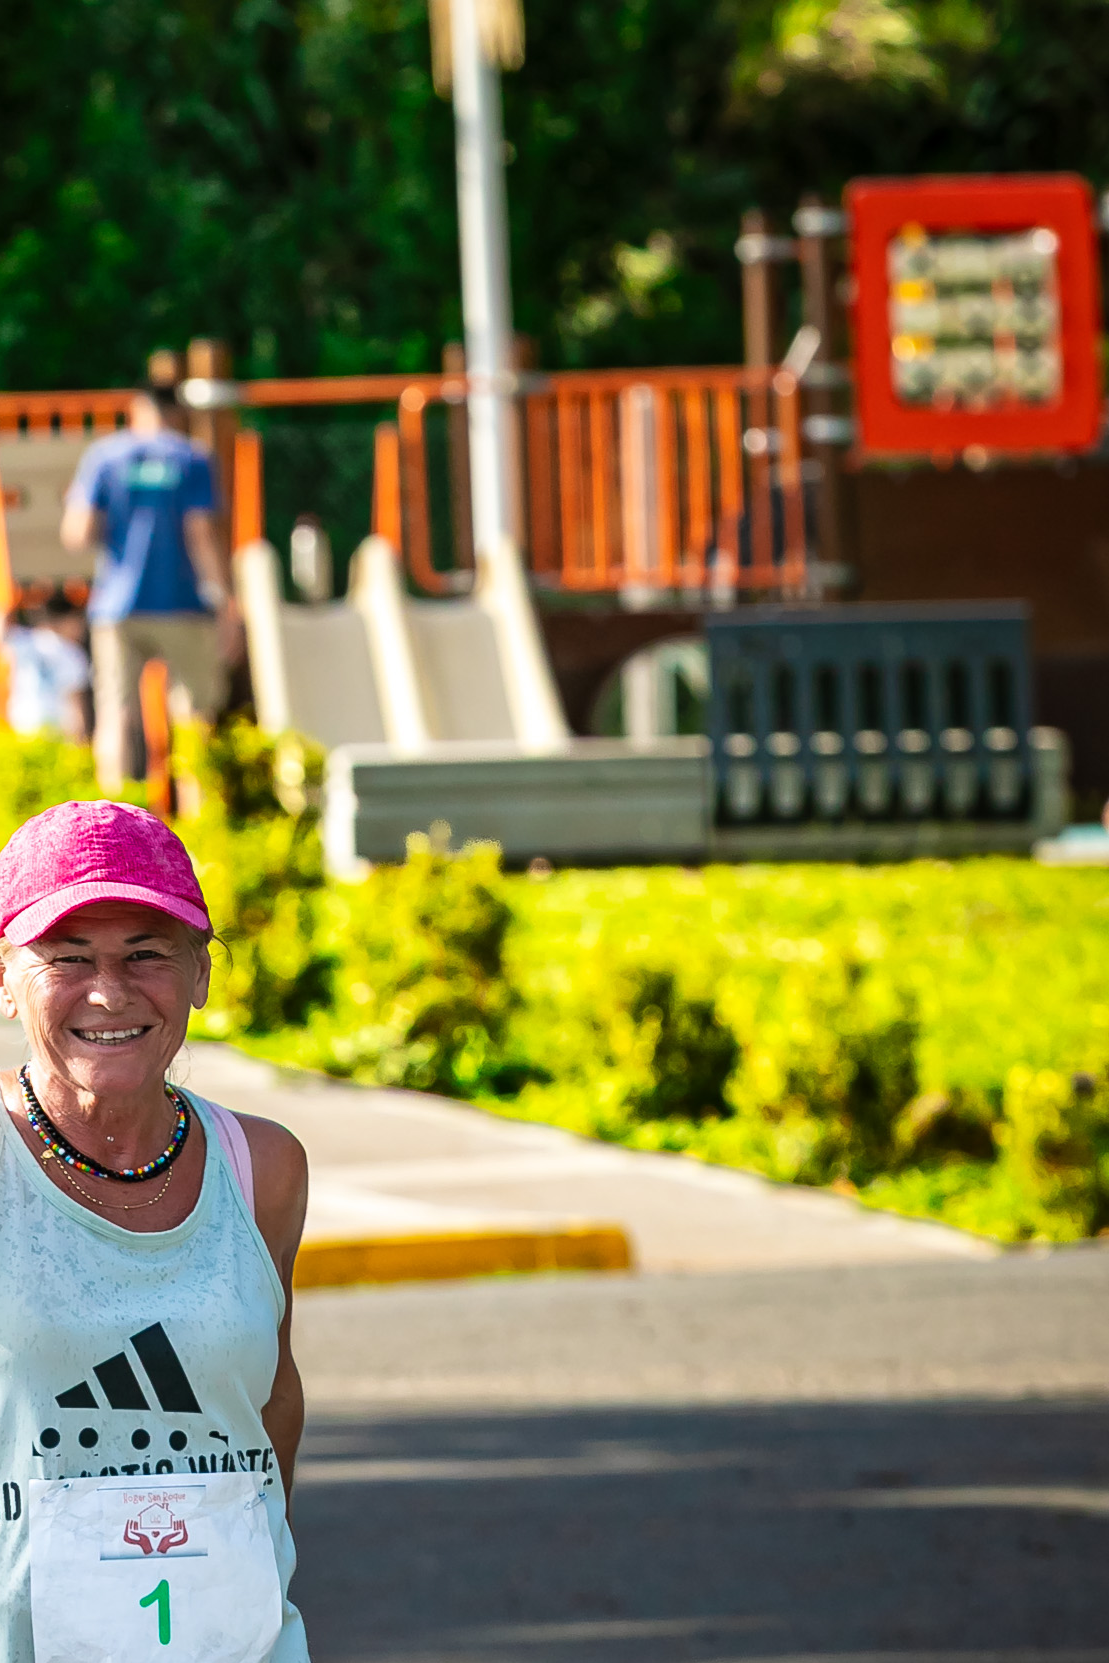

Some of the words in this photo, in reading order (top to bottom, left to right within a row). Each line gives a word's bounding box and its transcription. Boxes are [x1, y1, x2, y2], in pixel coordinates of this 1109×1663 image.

[123, 1492, 146, 1504] Hogar
[147, 1492, 162, 1503] San
[162, 1491, 186, 1503] Roque
[139, 1579, 171, 1646] 1
